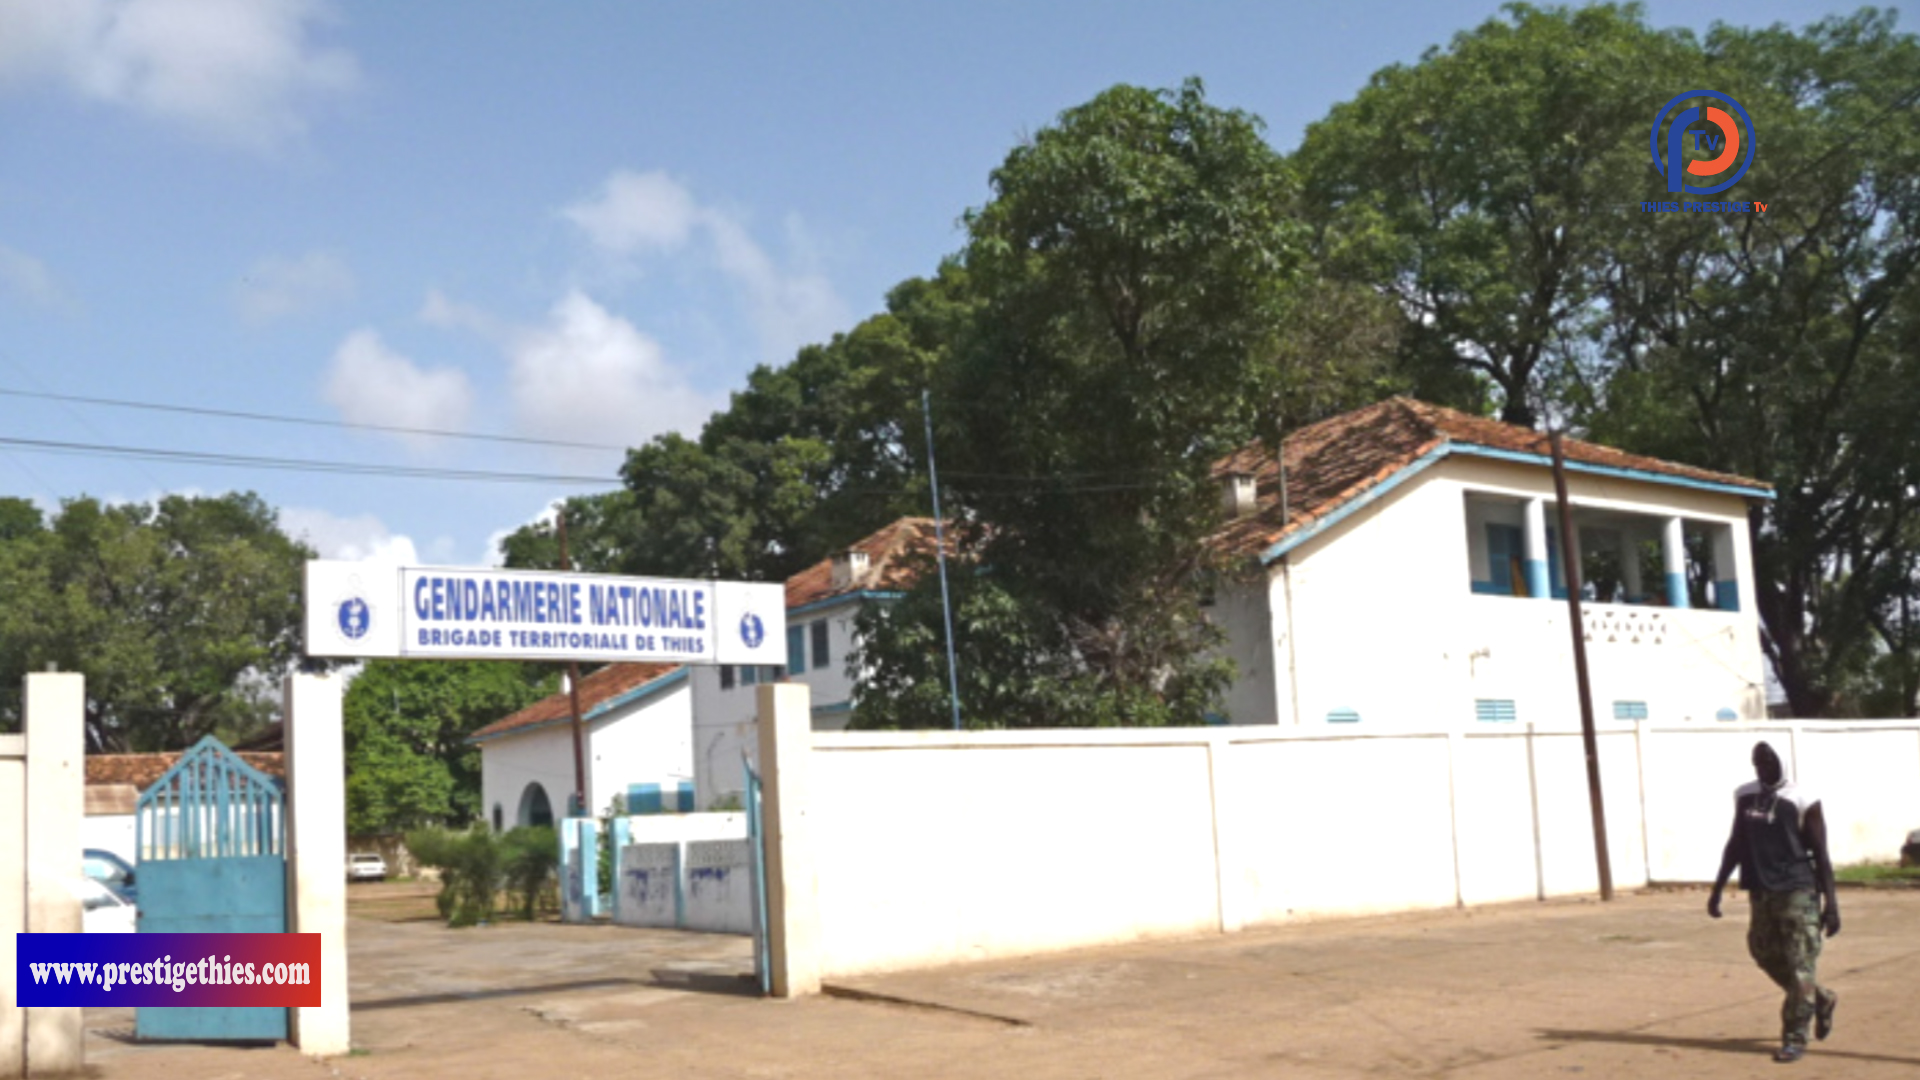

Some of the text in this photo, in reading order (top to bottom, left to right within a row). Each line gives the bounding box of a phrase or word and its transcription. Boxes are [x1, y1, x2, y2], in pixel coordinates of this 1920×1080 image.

[414, 576, 705, 629] GENDARMERIE NATIONALE
[418, 628, 704, 653] BRIGADE TERRITORIALE DE THIES
